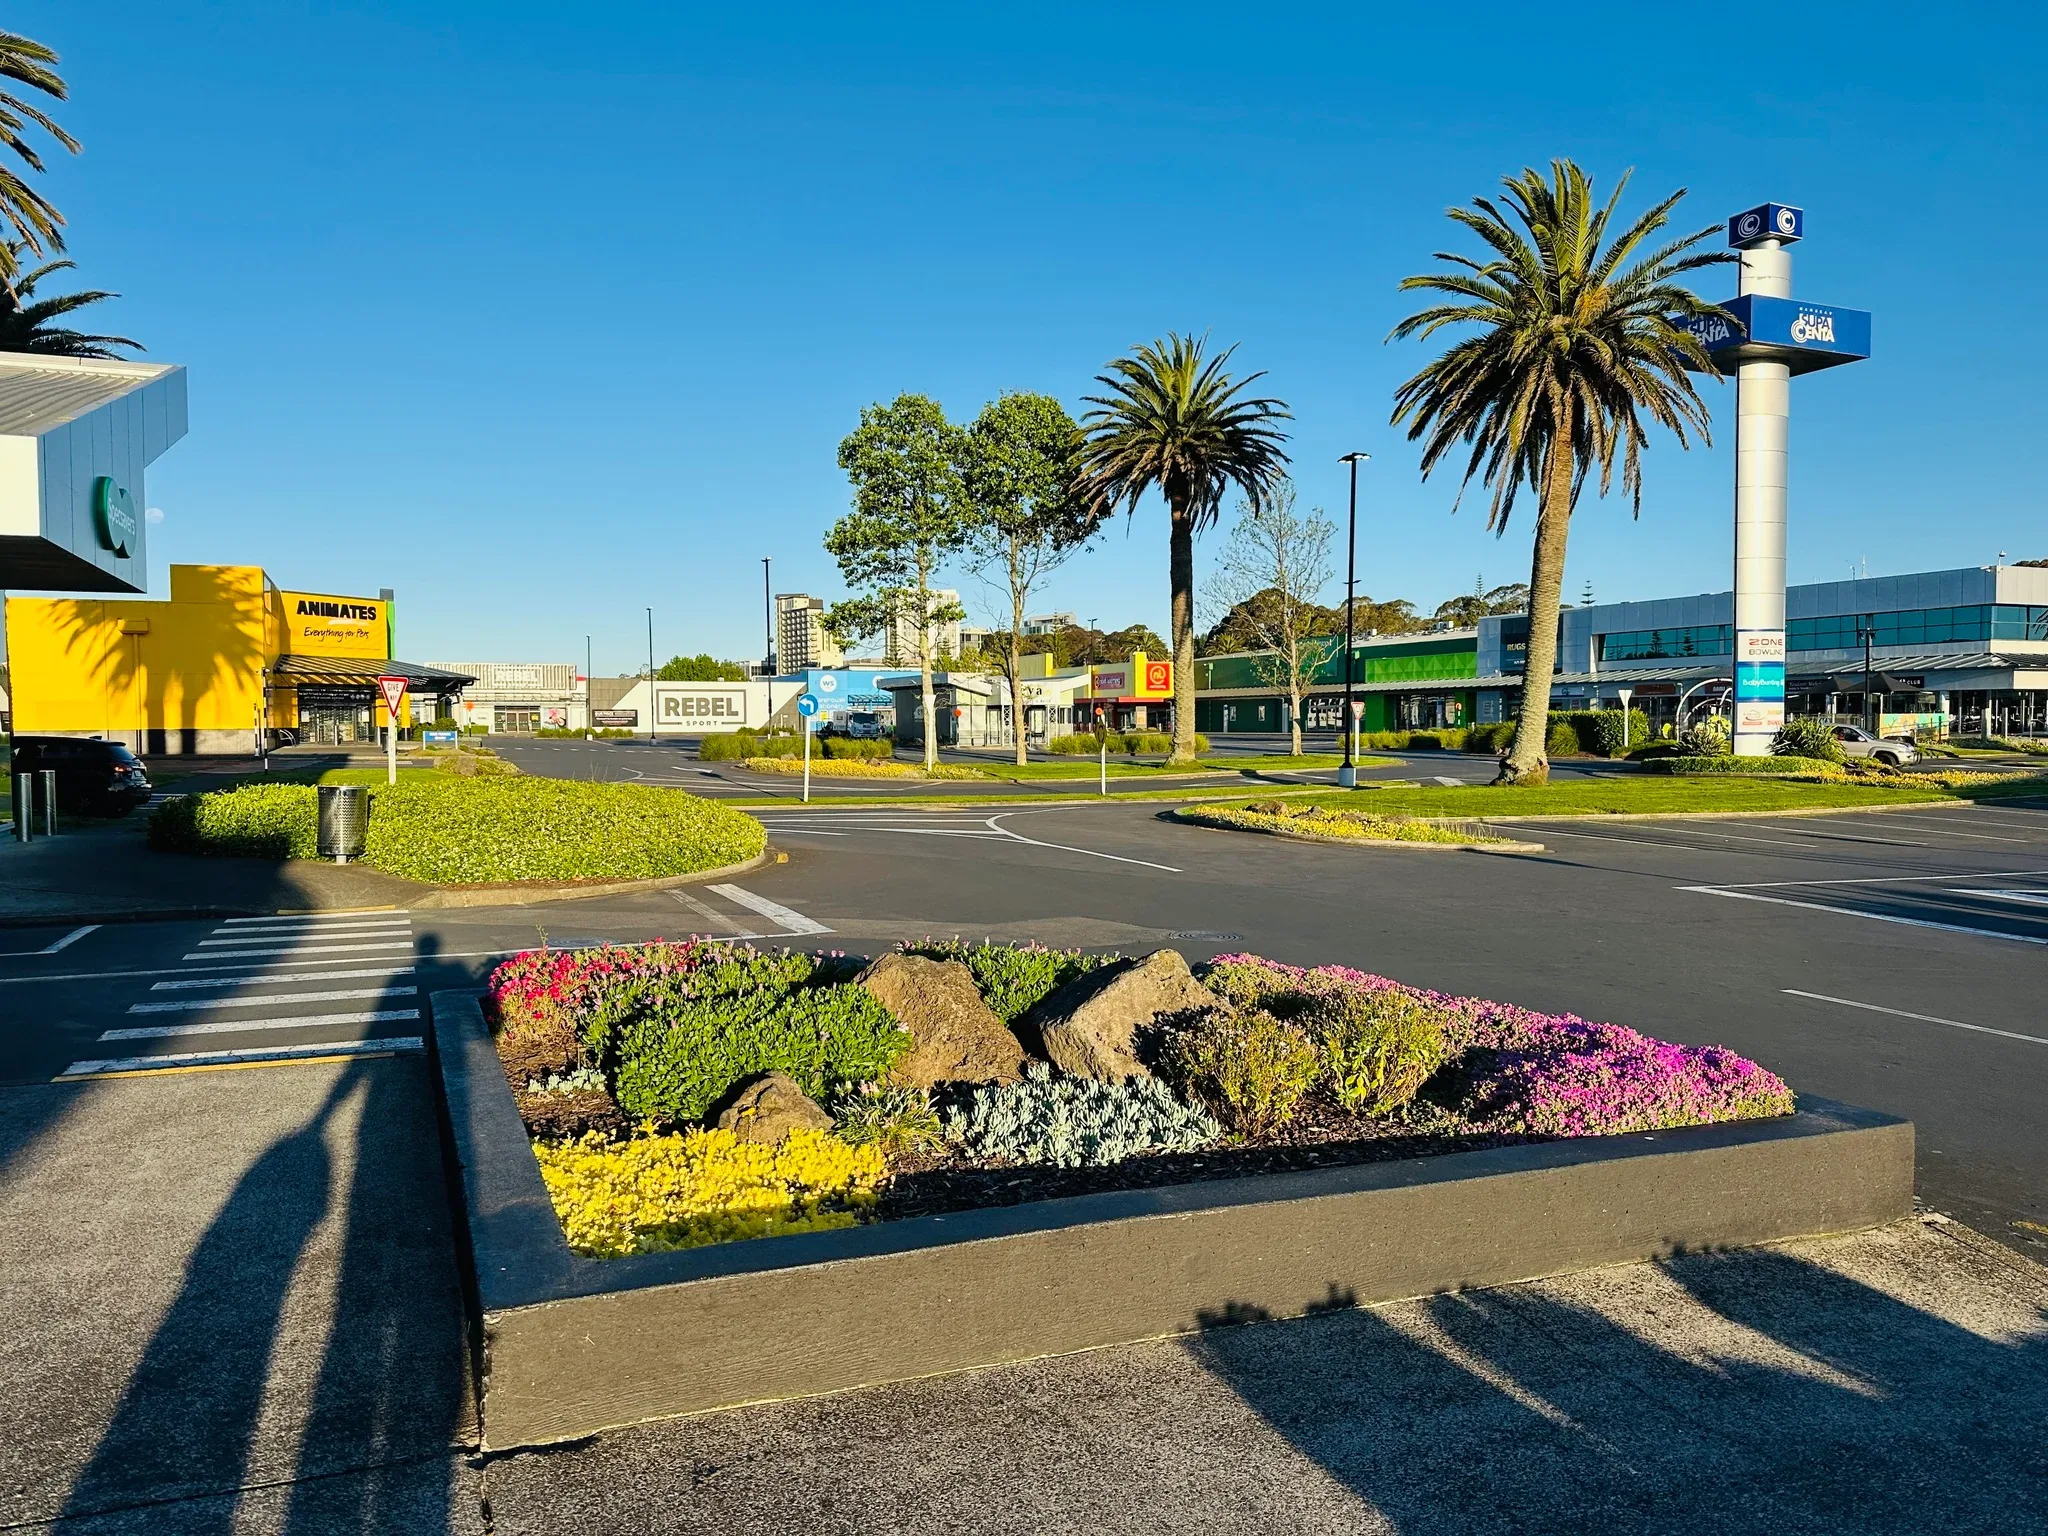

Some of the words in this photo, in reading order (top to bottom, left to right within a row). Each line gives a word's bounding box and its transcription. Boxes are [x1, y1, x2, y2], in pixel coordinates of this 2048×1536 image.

[1791, 319, 1836, 343] CENTA
[1801, 313, 1831, 331] SUPA
[107, 497, 135, 536] Specsavers
[296, 600, 377, 620] ANIMATES
[304, 626, 344, 642] Everything
[356, 628, 370, 640] Pets
[1748, 638, 1783, 646] ZONE
[1506, 642, 1526, 651] RUGS
[387, 682, 399, 691] GIVE
[664, 697, 739, 717] REBEL
